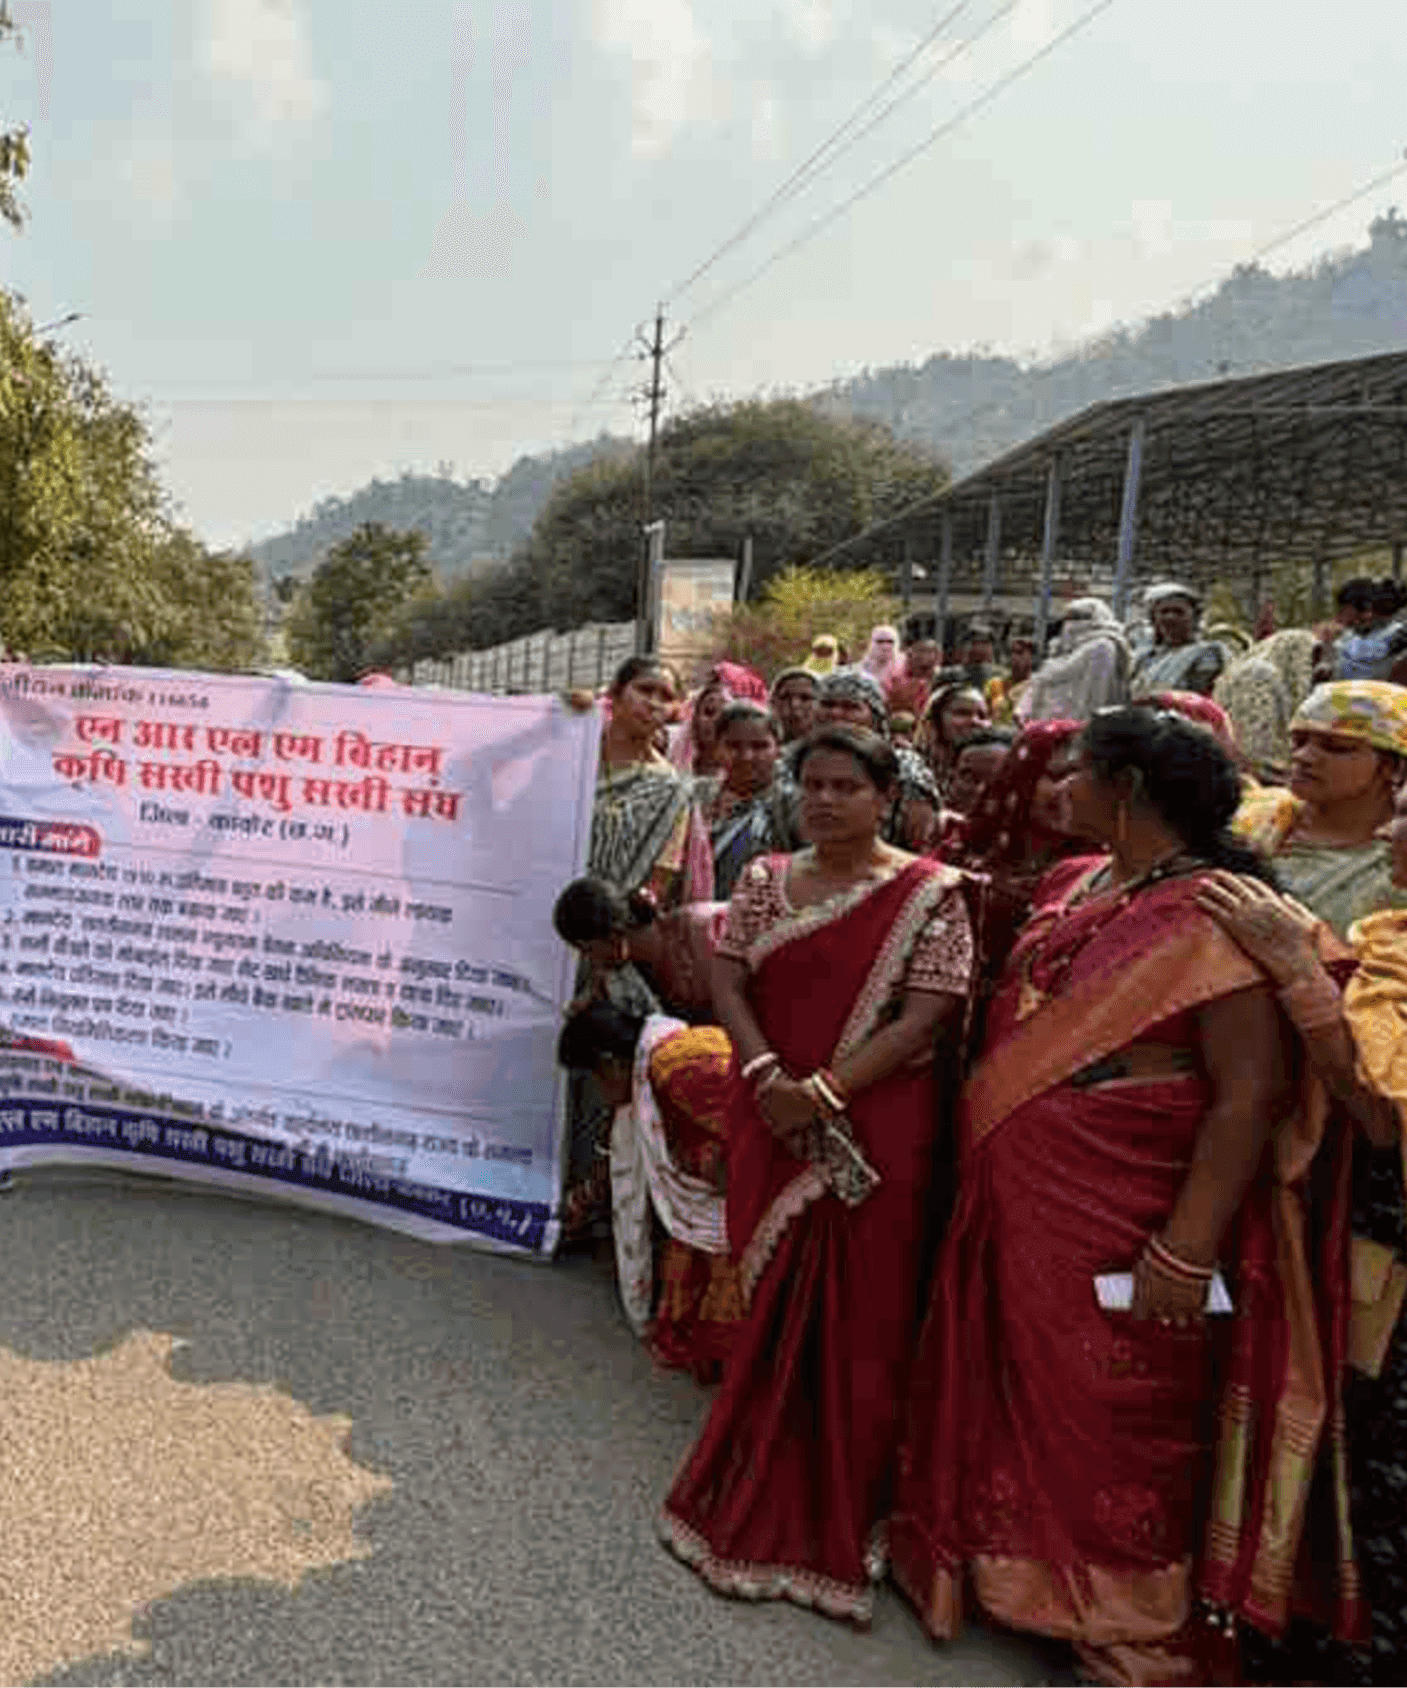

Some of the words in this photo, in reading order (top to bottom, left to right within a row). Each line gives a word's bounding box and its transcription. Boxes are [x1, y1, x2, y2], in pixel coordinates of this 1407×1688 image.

[74, 716, 126, 744] एन
[134, 720, 196, 751] आर
[206, 725, 261, 758] एल
[273, 733, 322, 763] एम
[334, 730, 447, 773] बिहान
[52, 749, 127, 792] कृषि
[138, 760, 224, 795] सखी
[230, 771, 292, 812] पशु
[302, 776, 391, 812] सखी
[396, 778, 464, 821] संघ
